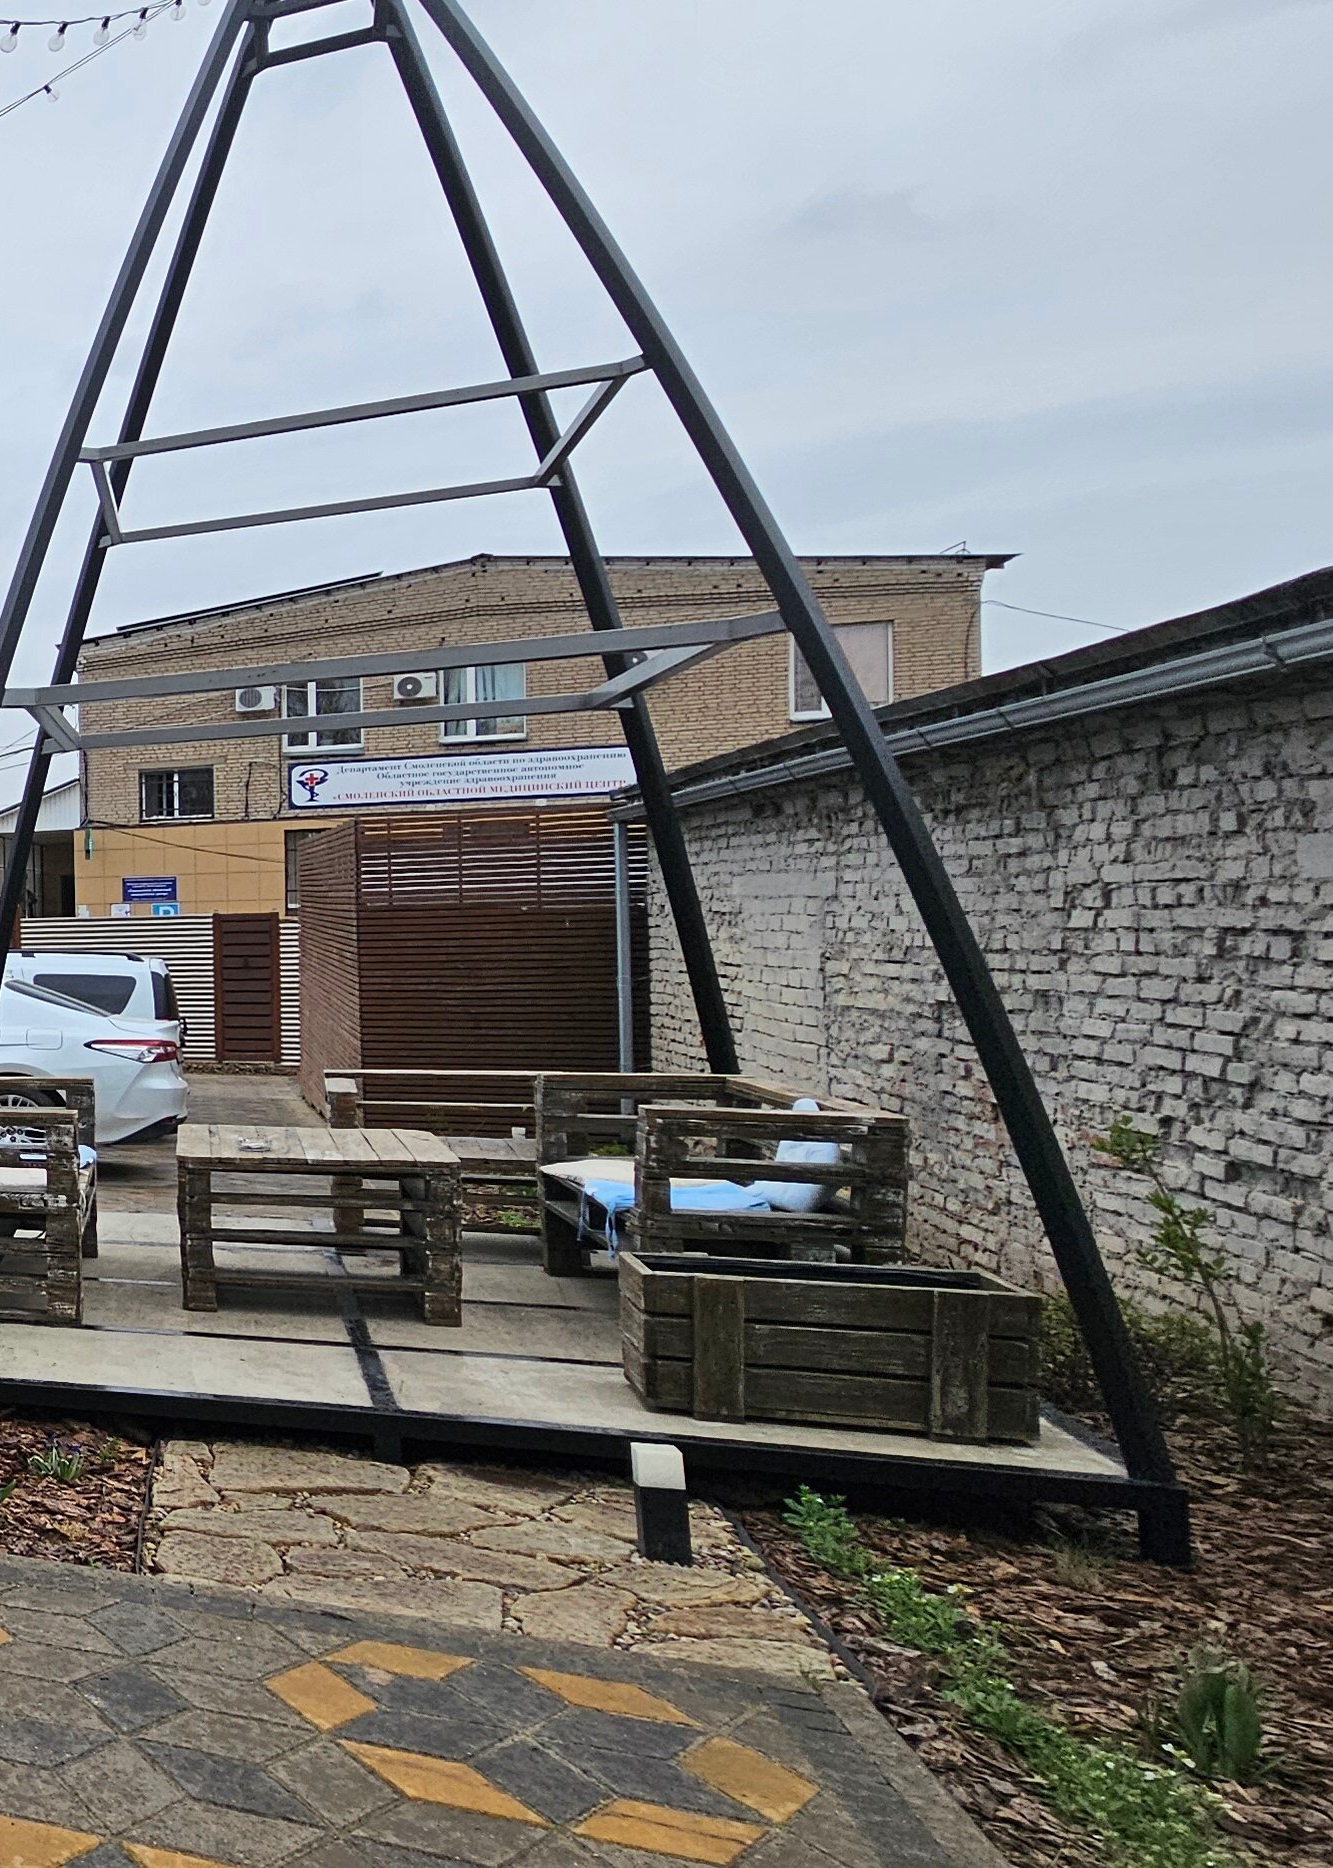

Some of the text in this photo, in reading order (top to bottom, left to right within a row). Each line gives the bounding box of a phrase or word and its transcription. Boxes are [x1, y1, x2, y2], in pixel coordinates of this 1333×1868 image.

[336, 765, 400, 775] Департамент
[404, 761, 466, 770] Смоленской
[469, 758, 510, 767] области
[528, 752, 627, 764] здравоохранению
[376, 763, 585, 780] Областное государственное автономное
[399, 773, 557, 788] учреждение здравоохранения
[417, 785, 486, 797] ОБЛАСТНОЙ
[490, 780, 582, 793] МЕДИЦИНСКИЙ
